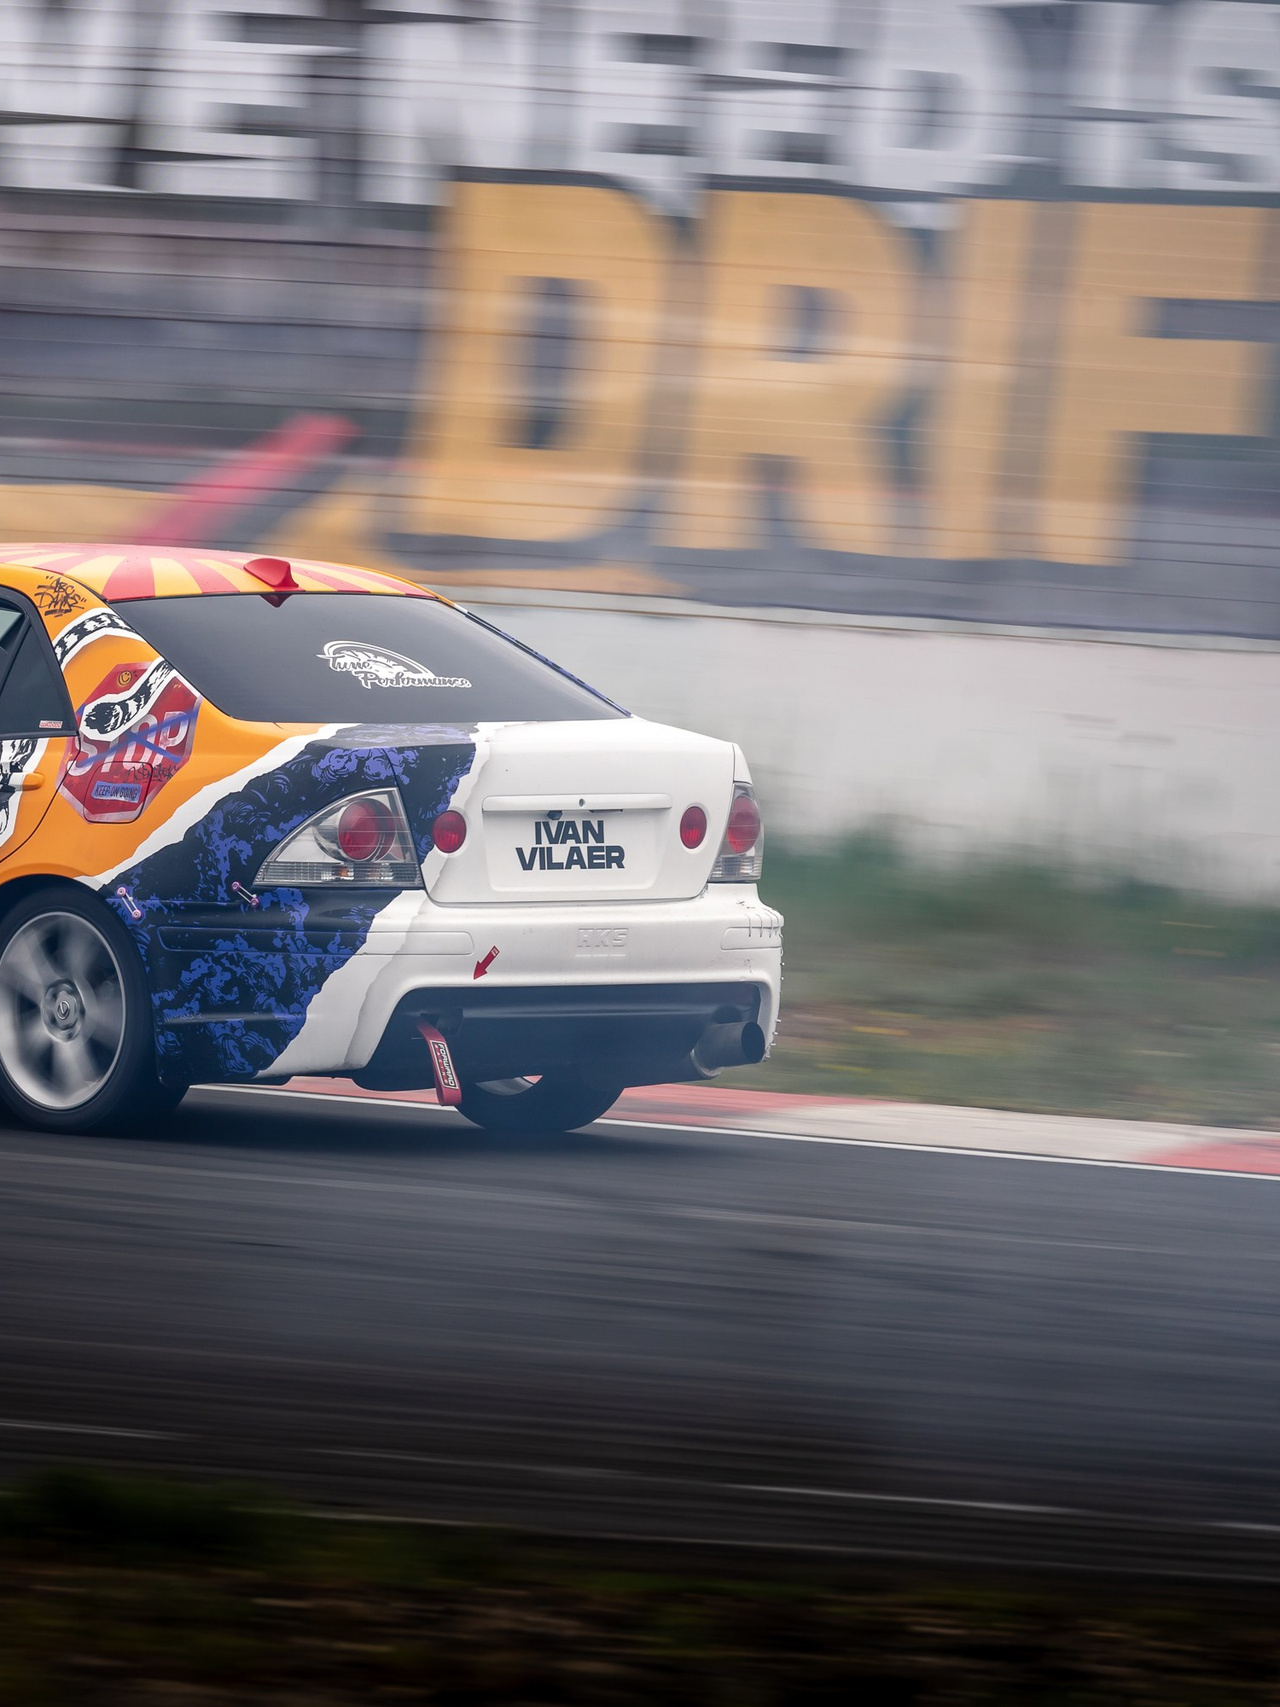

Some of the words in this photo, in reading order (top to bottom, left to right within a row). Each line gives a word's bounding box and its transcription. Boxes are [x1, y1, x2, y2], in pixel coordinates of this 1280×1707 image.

[535, 820, 604, 845] IVAN
[515, 845, 625, 871] VILAER
[438, 1042, 455, 1087] FORWARD
